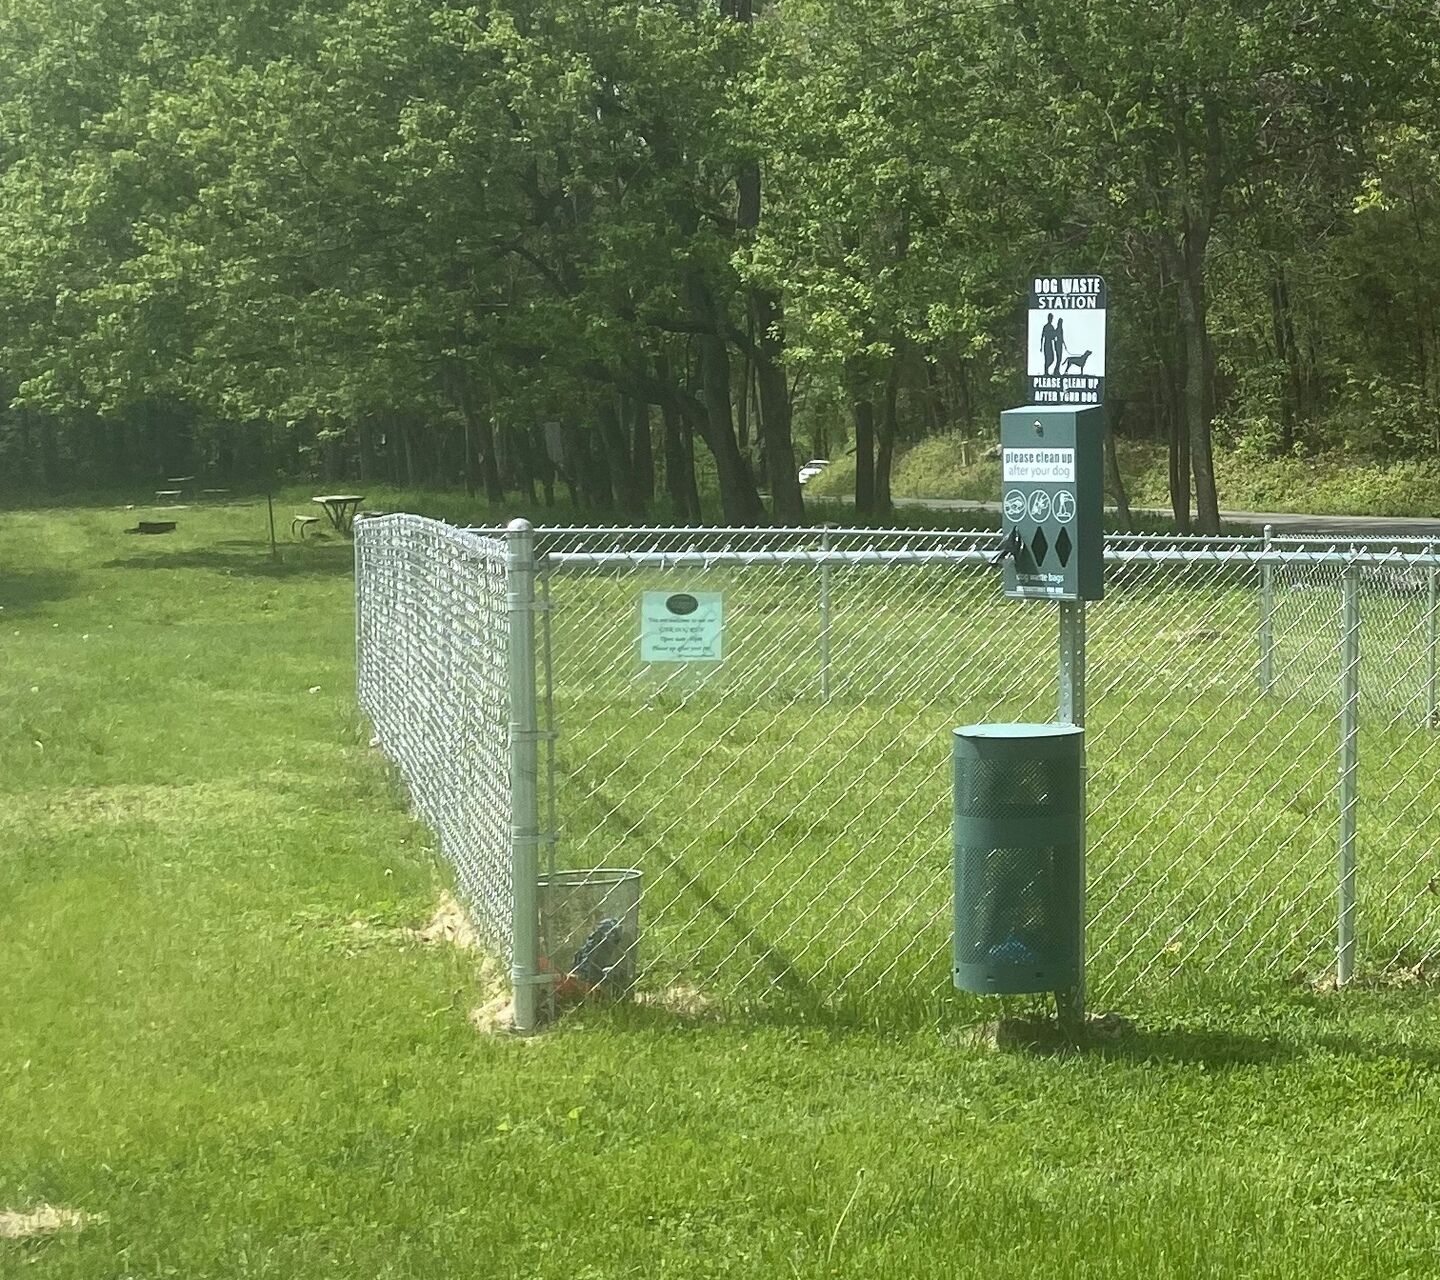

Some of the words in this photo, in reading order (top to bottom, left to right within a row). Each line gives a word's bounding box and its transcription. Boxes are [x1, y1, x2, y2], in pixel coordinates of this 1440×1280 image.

[1034, 278, 1058, 294] DOG
[1061, 278, 1100, 294] WASTE
[1038, 296, 1097, 309] STATION
[1033, 377, 1061, 388] PLEASE
[1063, 377, 1087, 389] CLEAN
[1088, 378, 1099, 389] UP
[1034, 391, 1058, 401] AFTER
[1060, 391, 1080, 402] YOUR
[1081, 392, 1098, 403] DOG
[1005, 452, 1034, 464] please
[1036, 451, 1060, 464] clean
[1061, 453, 1073, 464] up
[1008, 464, 1029, 476] after
[1031, 467, 1050, 478] your
[1052, 465, 1070, 478] dog
[1048, 572, 1064, 584] bags
